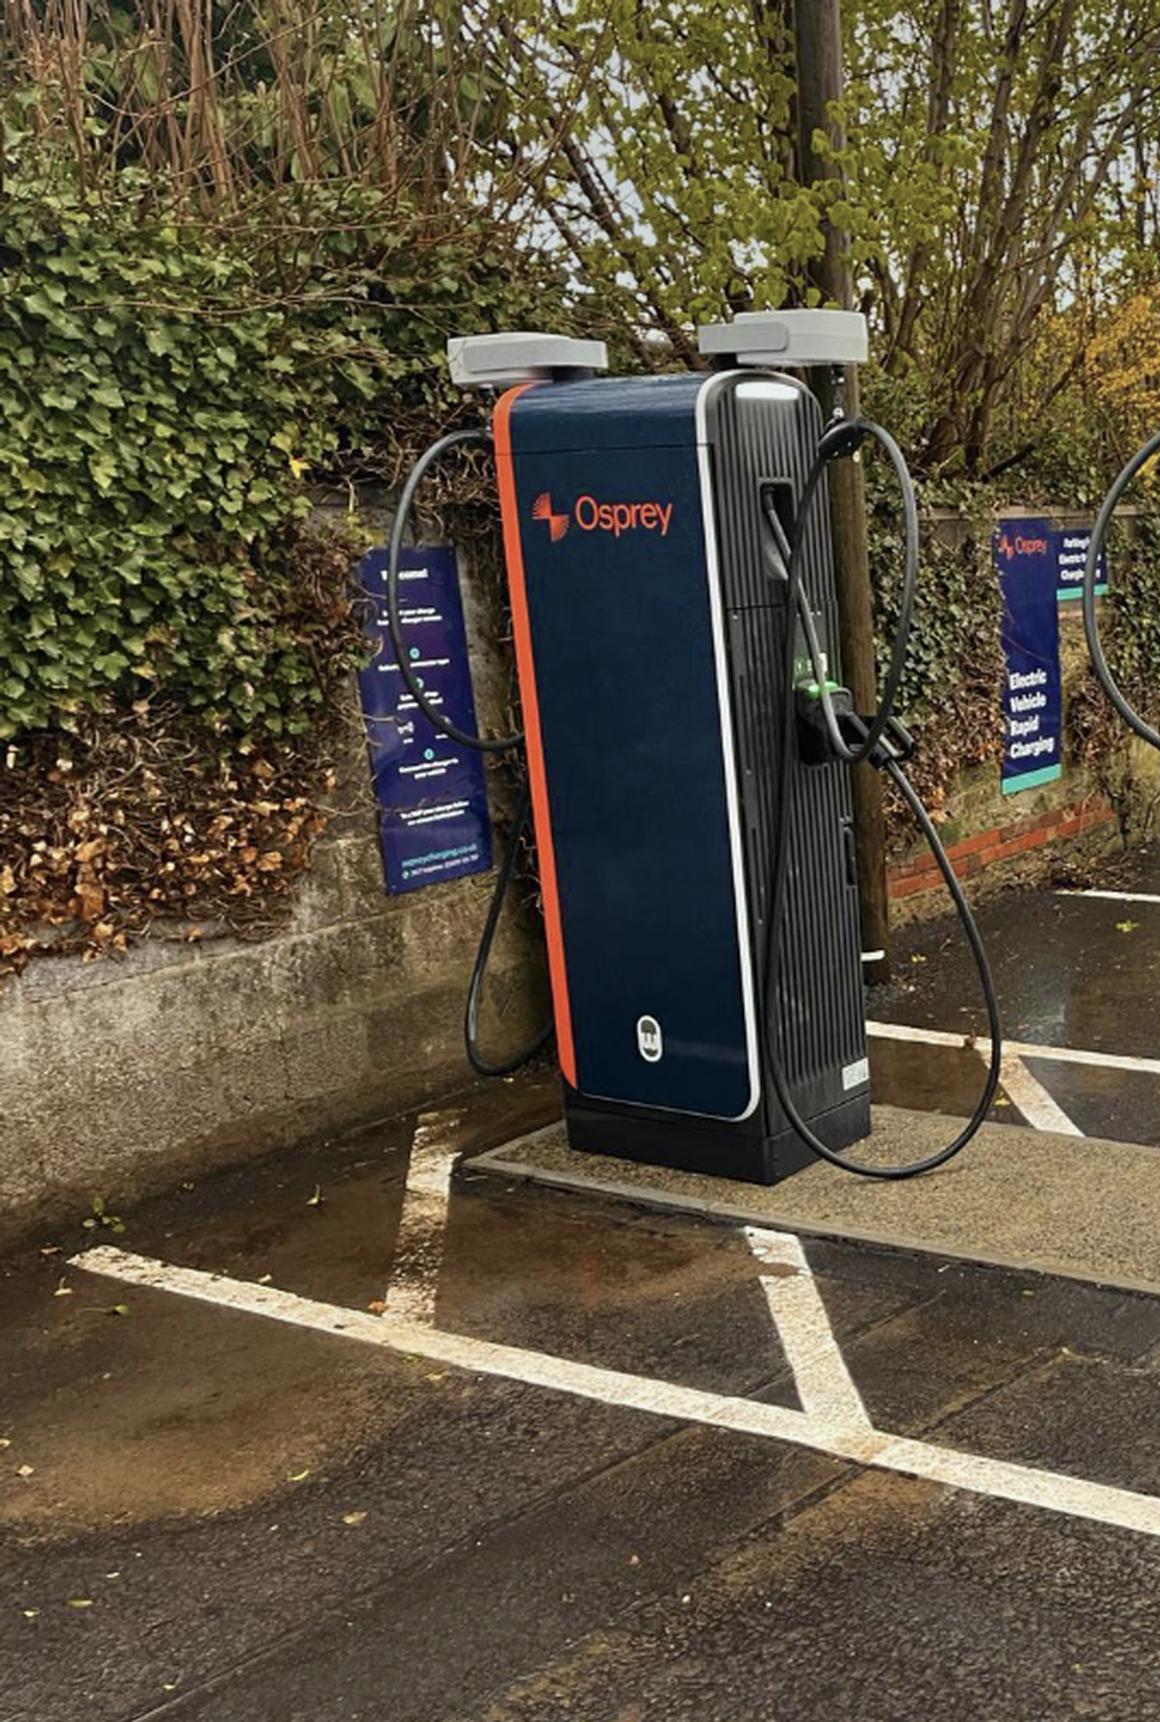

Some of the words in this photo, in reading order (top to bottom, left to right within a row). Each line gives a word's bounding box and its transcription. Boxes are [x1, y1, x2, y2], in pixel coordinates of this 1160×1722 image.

[575, 495, 672, 538] Osprey
[1015, 536, 1048, 556] Osprey
[1009, 669, 1047, 691] Electric
[1010, 691, 1047, 713] Vehicle
[1010, 714, 1039, 736] Rapid
[1010, 737, 1055, 759] Charging
